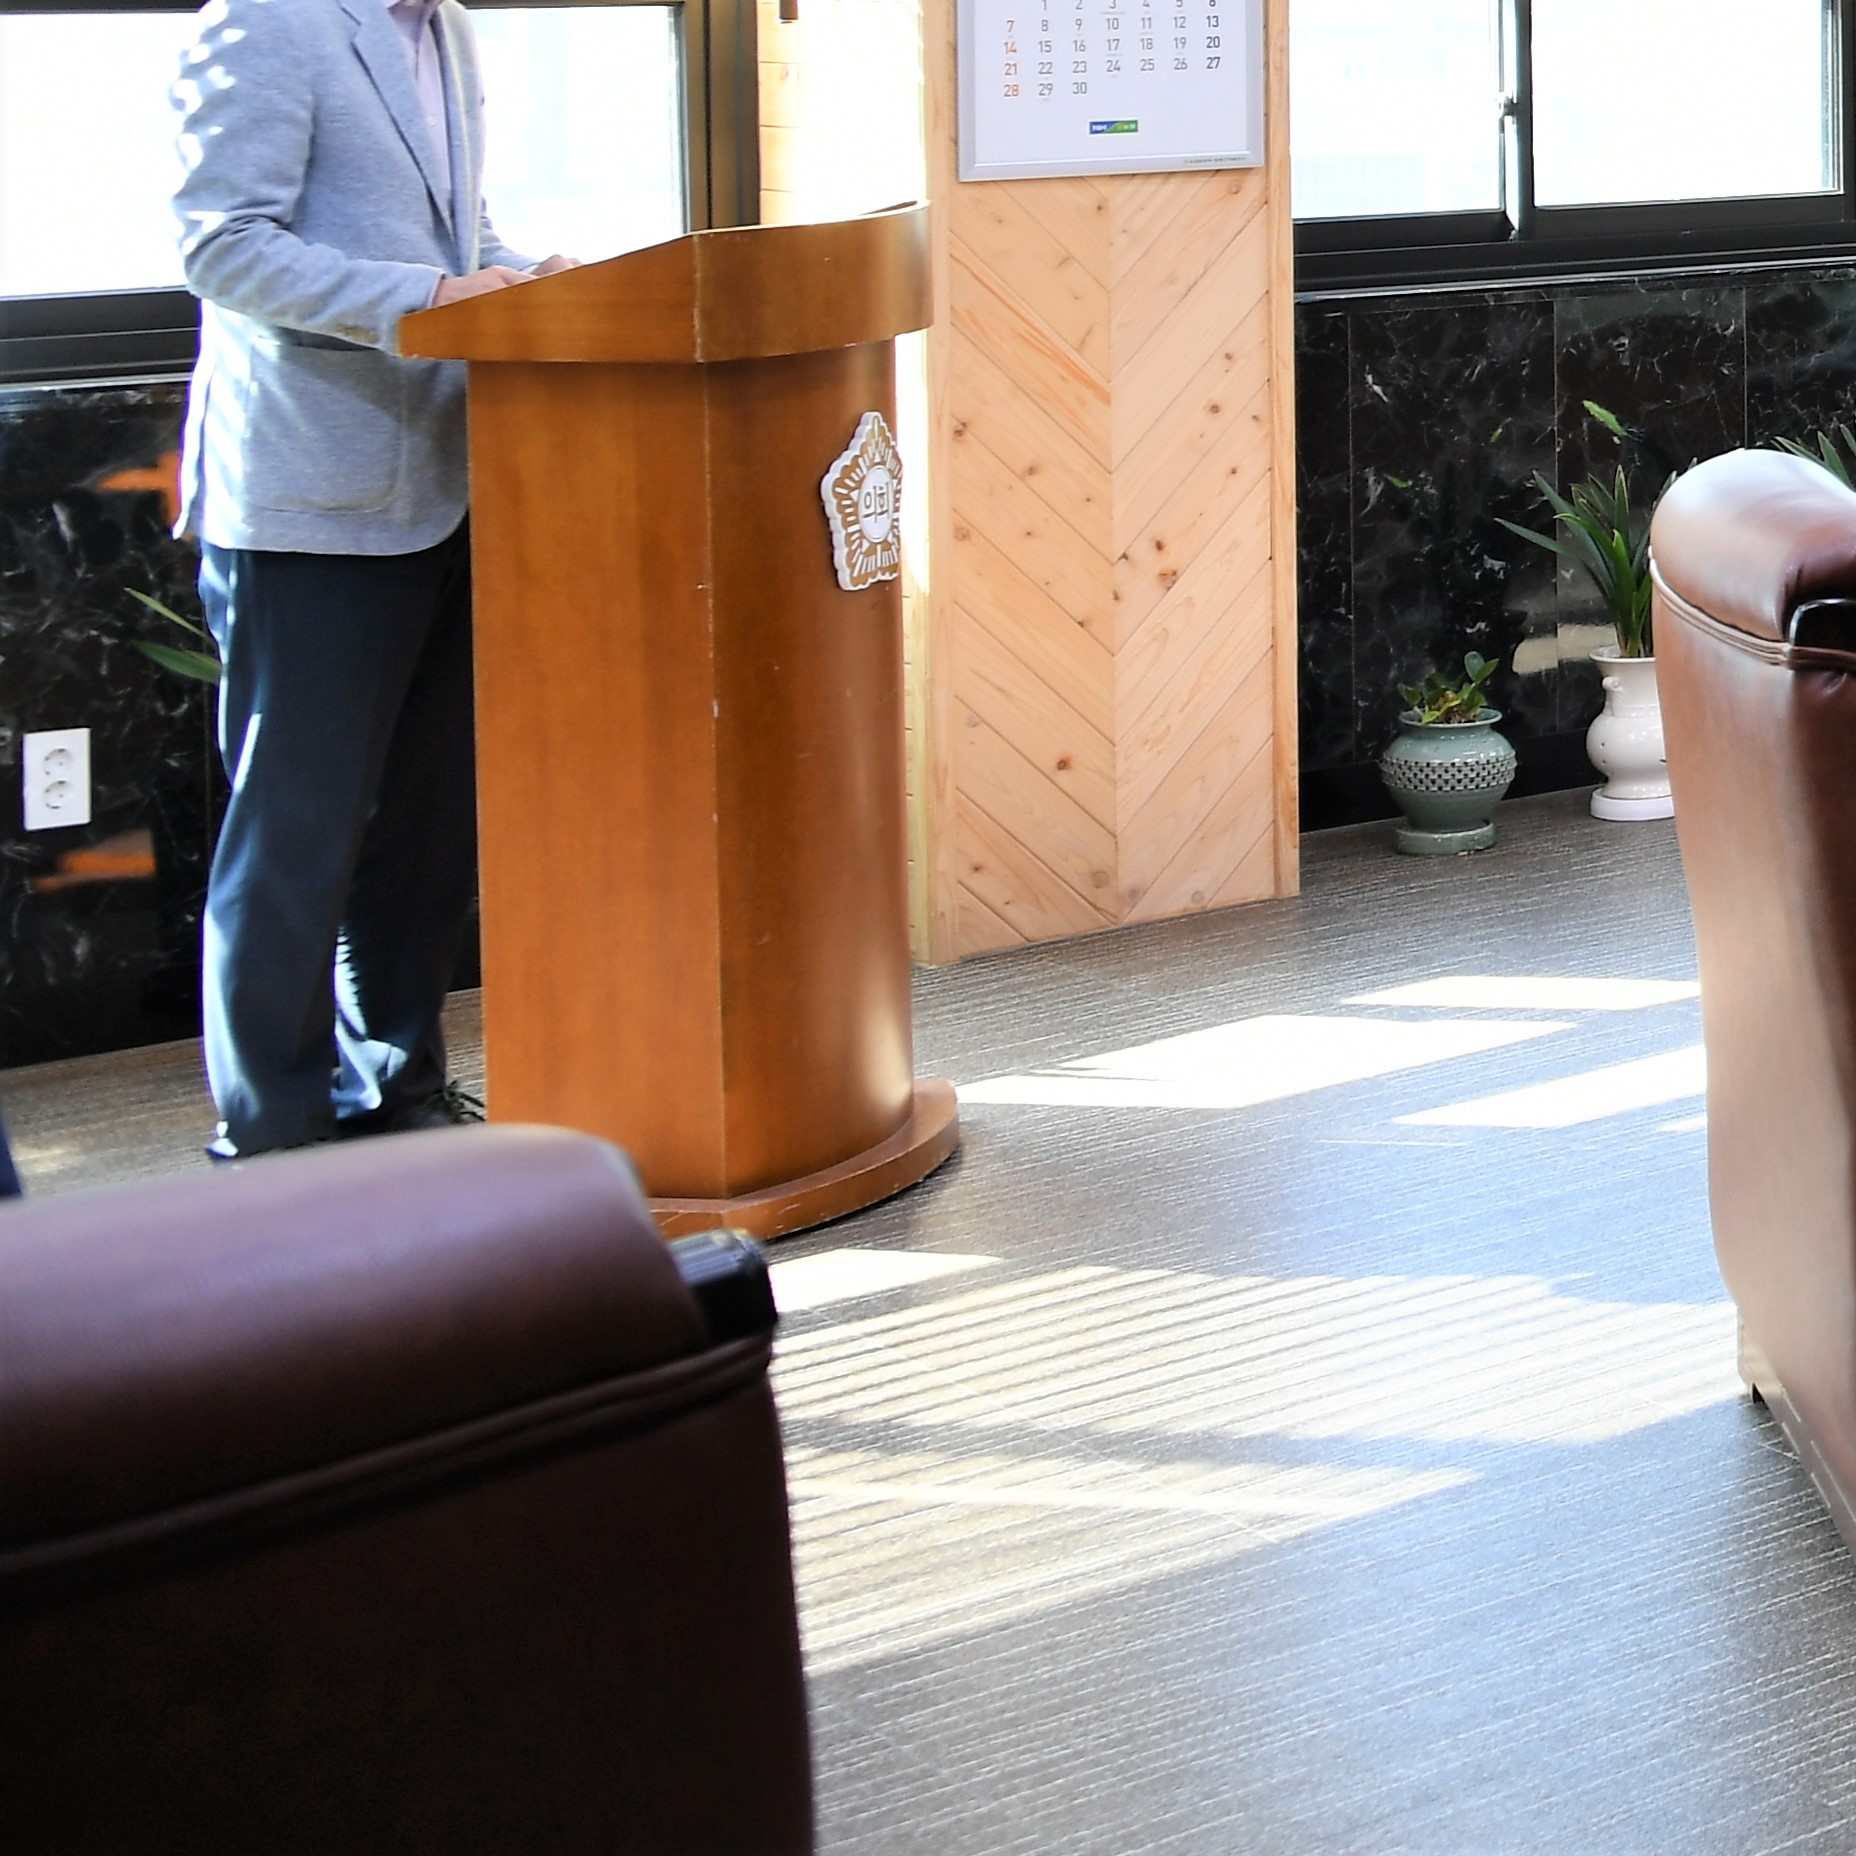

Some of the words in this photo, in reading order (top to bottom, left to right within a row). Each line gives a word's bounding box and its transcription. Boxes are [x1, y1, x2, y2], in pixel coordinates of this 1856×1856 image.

[1006, 19, 1015, 32] 7
[1041, 19, 1049, 31] 8
[1075, 18, 1083, 30] 9
[1106, 17, 1120, 30] 10
[1140, 17, 1152, 29] 11
[1173, 15, 1186, 28] 12
[1205, 15, 1220, 27] 13
[1003, 41, 1017, 54] 14
[1038, 40, 1052, 53] 15
[1073, 39, 1086, 51] 16
[1106, 38, 1121, 50] 17
[1140, 37, 1153, 49] 18
[1173, 36, 1187, 48] 19
[1205, 35, 1221, 48] 20
[1004, 62, 1018, 75] 21
[1038, 62, 1053, 75] 22
[1072, 60, 1087, 73] 23
[1106, 60, 1121, 73] 24
[1140, 59, 1155, 71] 25
[1173, 57, 1188, 70] 26
[1206, 56, 1221, 69] 27
[1003, 84, 1019, 97] 28
[1038, 82, 1053, 95] 29
[1072, 81, 1088, 94] 30
[863, 481, 890, 523] 의회
